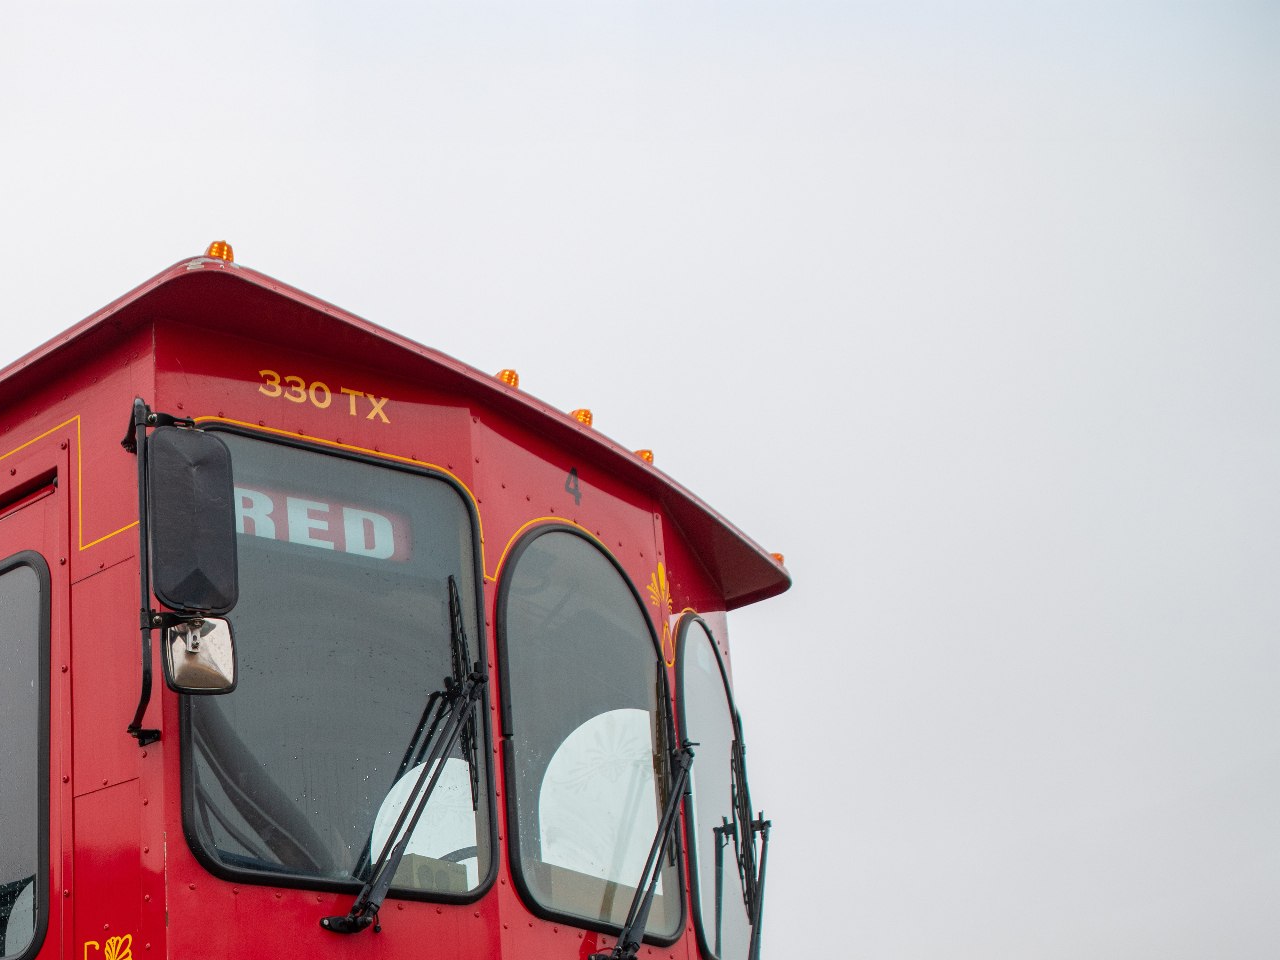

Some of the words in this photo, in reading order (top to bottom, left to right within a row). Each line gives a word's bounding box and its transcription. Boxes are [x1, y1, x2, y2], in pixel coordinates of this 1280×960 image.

[259, 369, 332, 409] 330
[340, 386, 391, 424] TX
[564, 467, 582, 506] 4
